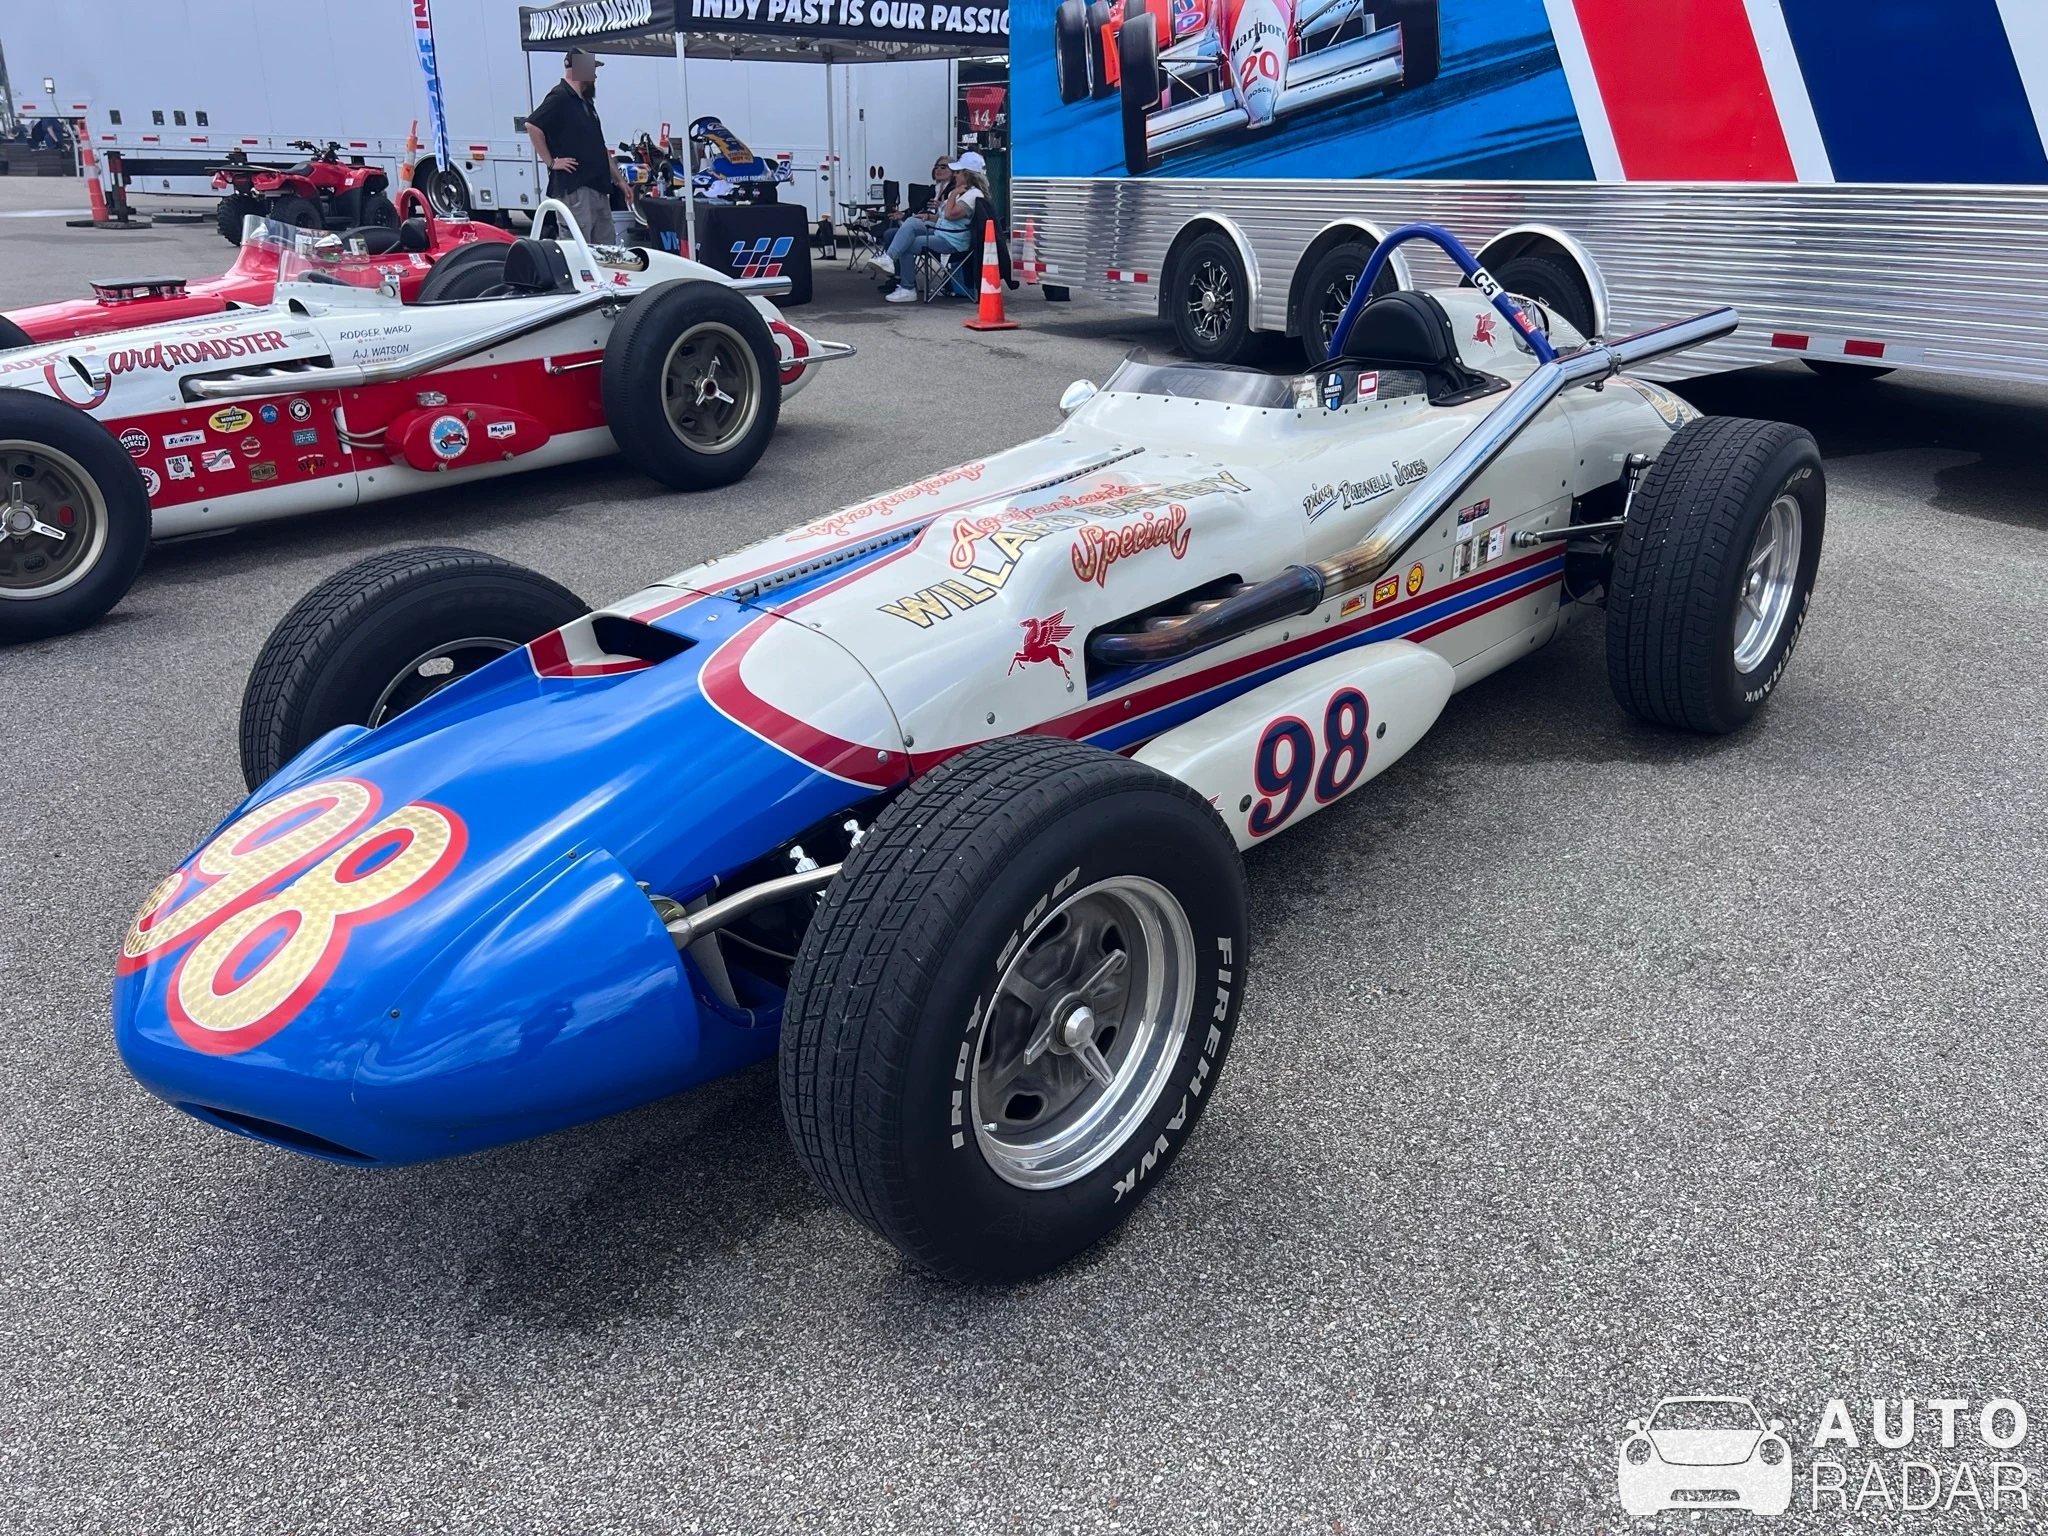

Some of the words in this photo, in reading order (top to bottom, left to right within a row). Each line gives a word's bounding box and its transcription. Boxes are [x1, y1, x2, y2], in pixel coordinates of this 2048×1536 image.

[528, 11, 550, 41] INDY
[547, 8, 571, 39] PAST
[569, 6, 582, 36] IS
[580, 3, 604, 35] OUR
[601, 0, 653, 32] PASSION
[691, 0, 759, 20] INDY
[766, 0, 833, 24] PAST
[838, 0, 865, 27] IS
[869, 5, 924, 30] OUR
[1240, 50, 1280, 94] 20
[974, 110, 991, 127] 14
[1474, 272, 1499, 297] C5
[164, 330, 289, 366] ROADSTER
[340, 328, 380, 340] RODGER
[383, 325, 412, 335] WARD
[371, 344, 410, 357] WATSON
[0, 353, 61, 374] ADER
[120, 434, 147, 444] PERFECT
[123, 440, 147, 450] CIRCLE
[490, 424, 513, 433] Mobil
[251, 466, 276, 477] PREMIER
[1338, 473, 1393, 511] PARNELLI
[1392, 459, 1428, 487] JONES
[876, 514, 1088, 630] WILLARD
[1076, 470, 1253, 519] BATTERY
[1071, 503, 1193, 589] Special
[1248, 685, 1370, 838] 98
[116, 777, 470, 1056] 98
[995, 866, 1081, 973] 500
[951, 995, 982, 1150] INDY
[1112, 937, 1233, 1204] FIREHAWK
